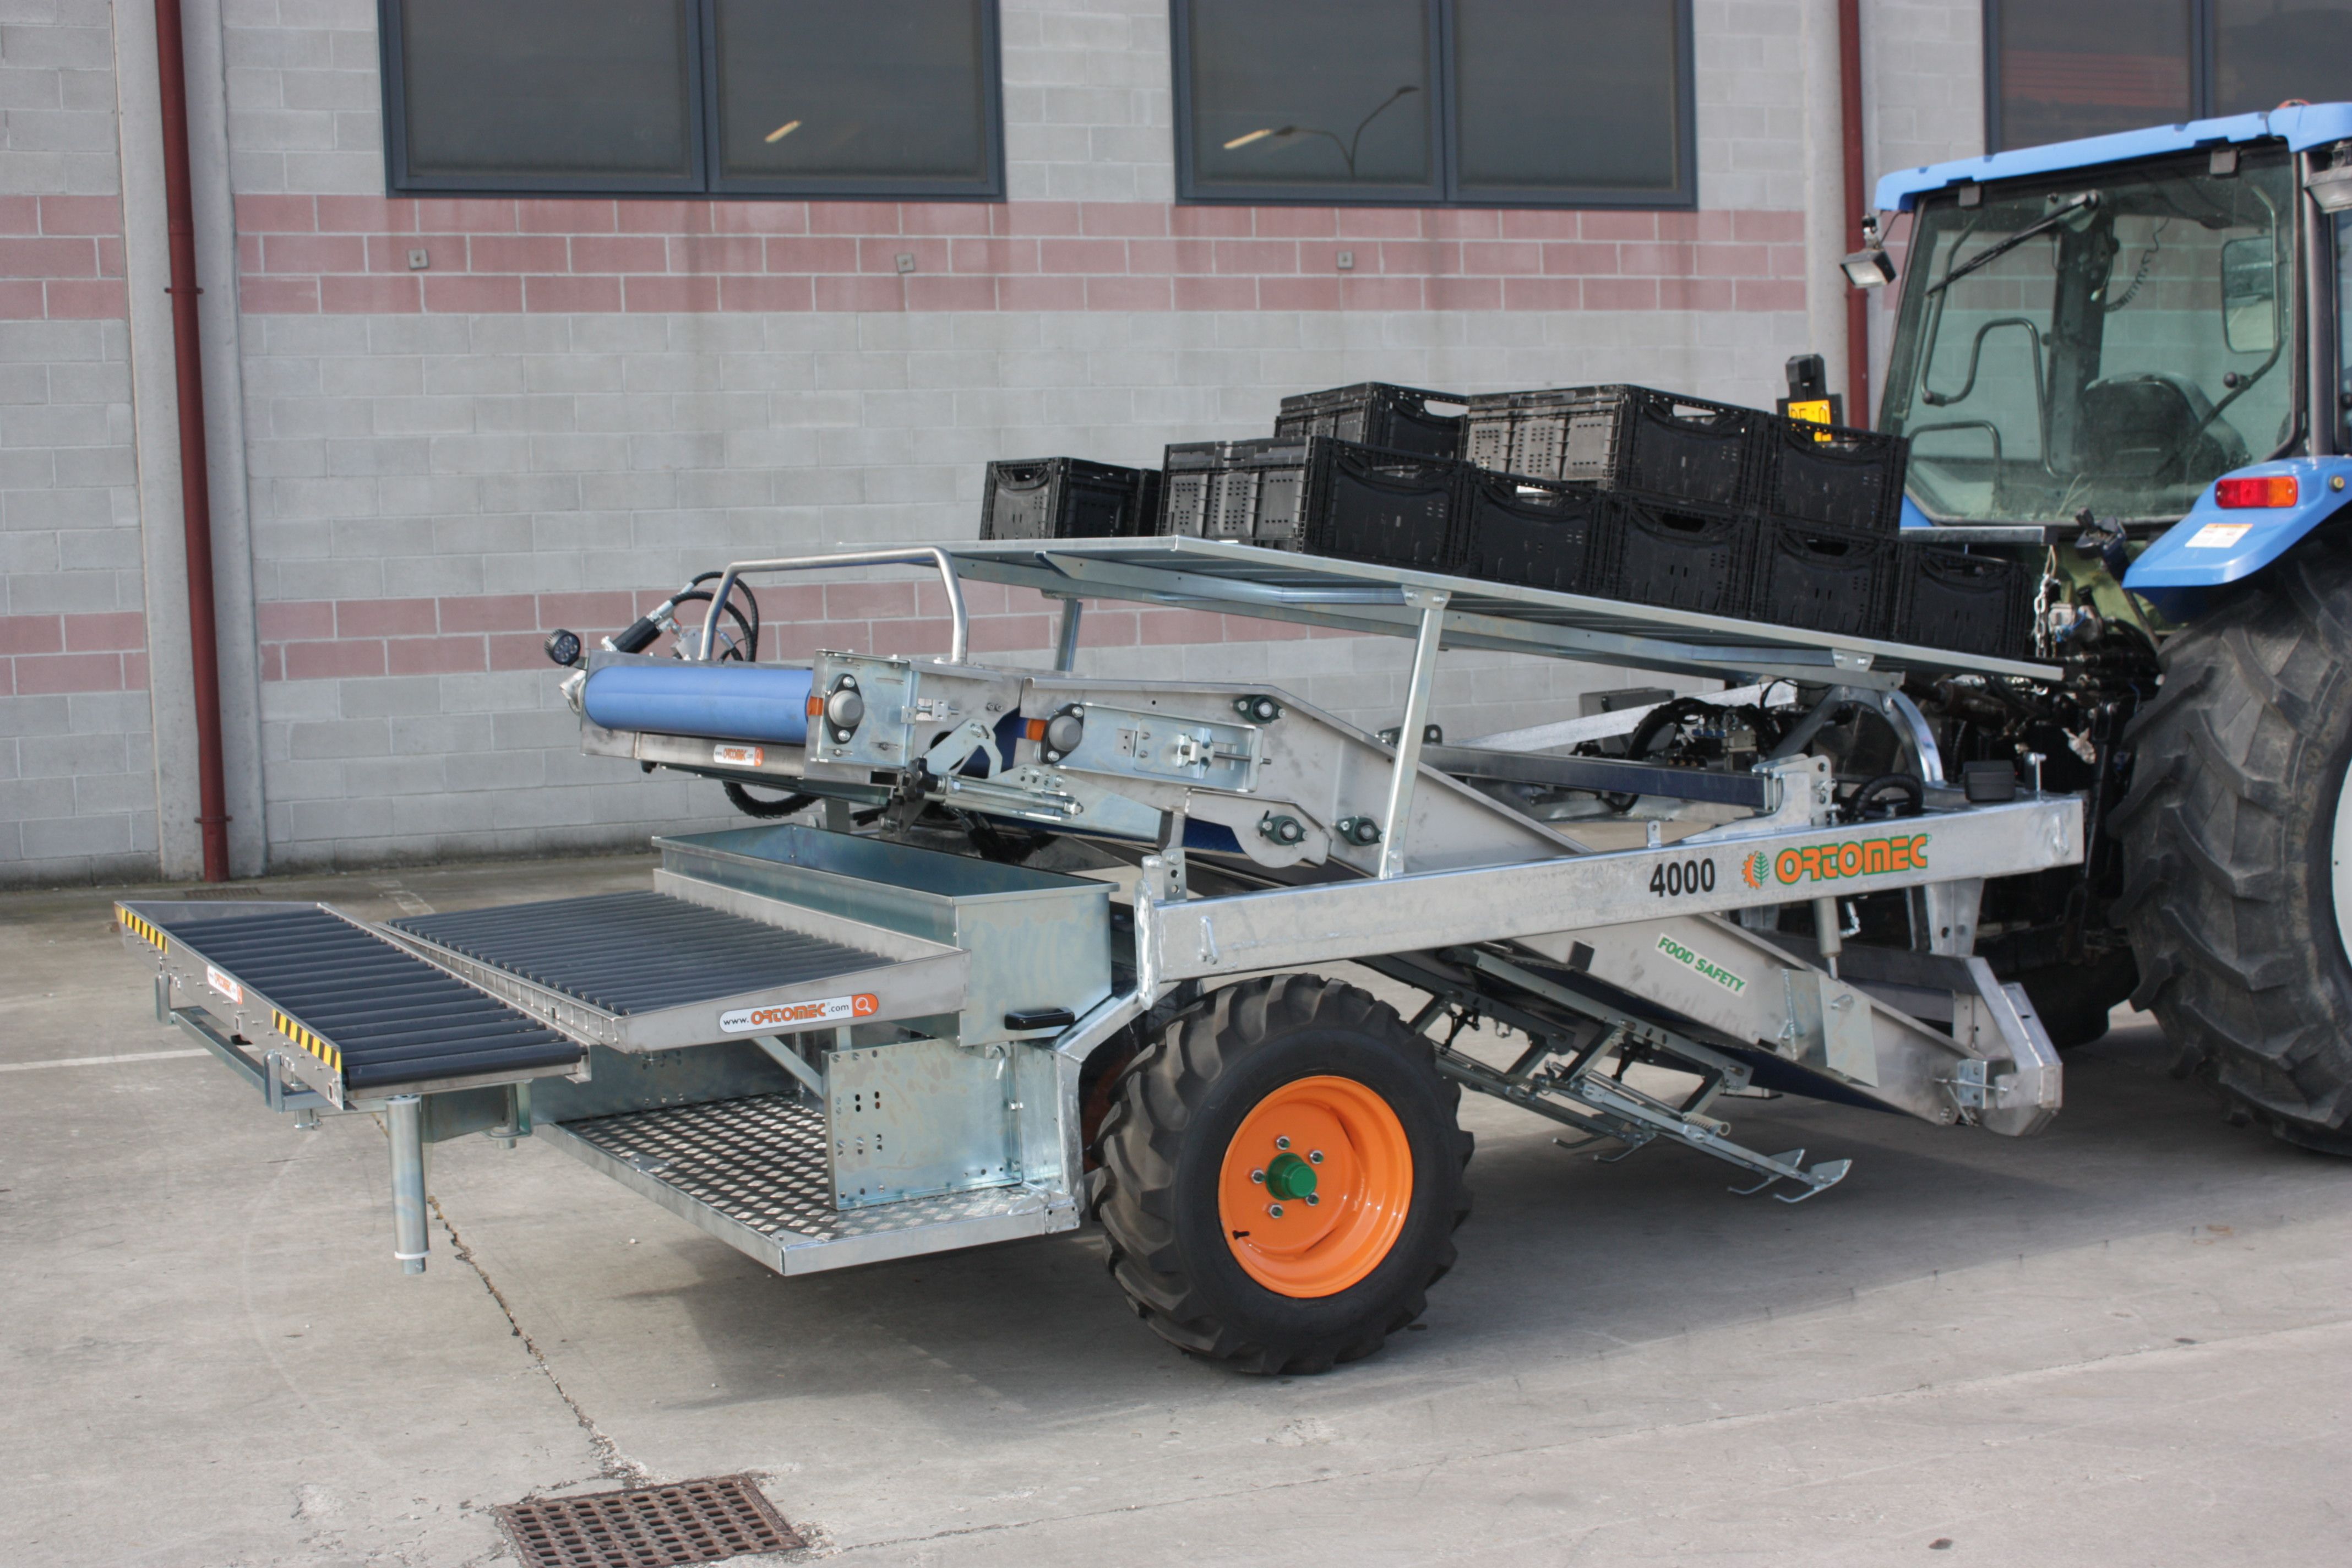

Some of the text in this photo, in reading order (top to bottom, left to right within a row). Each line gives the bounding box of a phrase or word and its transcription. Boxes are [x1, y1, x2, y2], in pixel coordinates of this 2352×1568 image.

[1649, 833, 1928, 897] 4000 ORTOMEC
[1658, 937, 1746, 992] FOOD SAFETY
